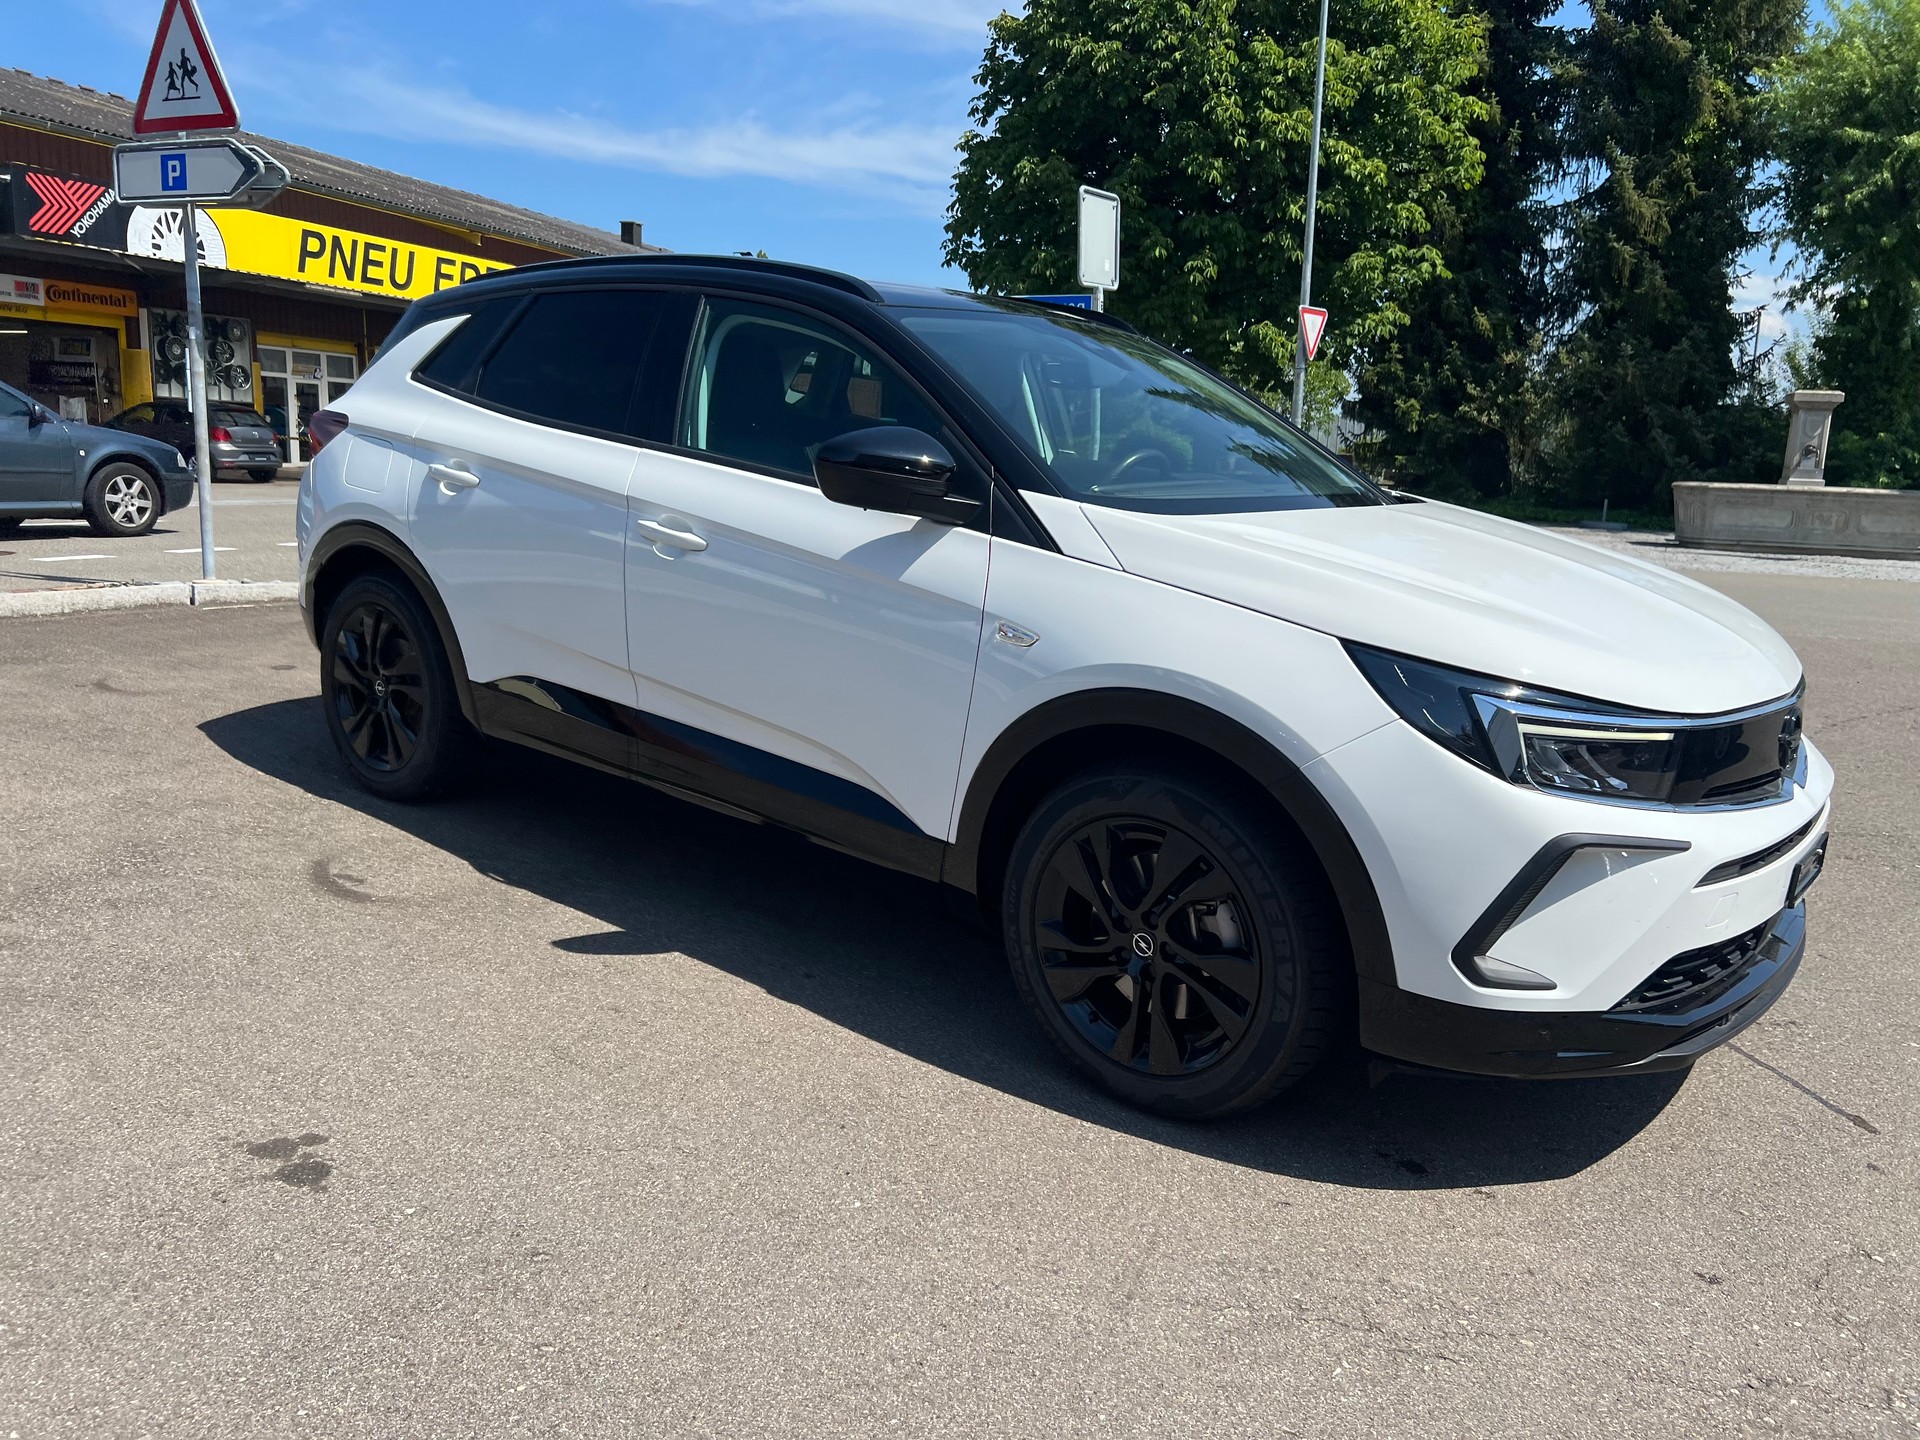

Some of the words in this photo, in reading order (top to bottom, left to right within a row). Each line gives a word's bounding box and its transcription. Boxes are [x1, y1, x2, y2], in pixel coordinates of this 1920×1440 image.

[168, 160, 181, 187] P
[298, 229, 415, 291] PNEU
[45, 285, 127, 308] Continental
[1200, 811, 1294, 1025] MINERVA
